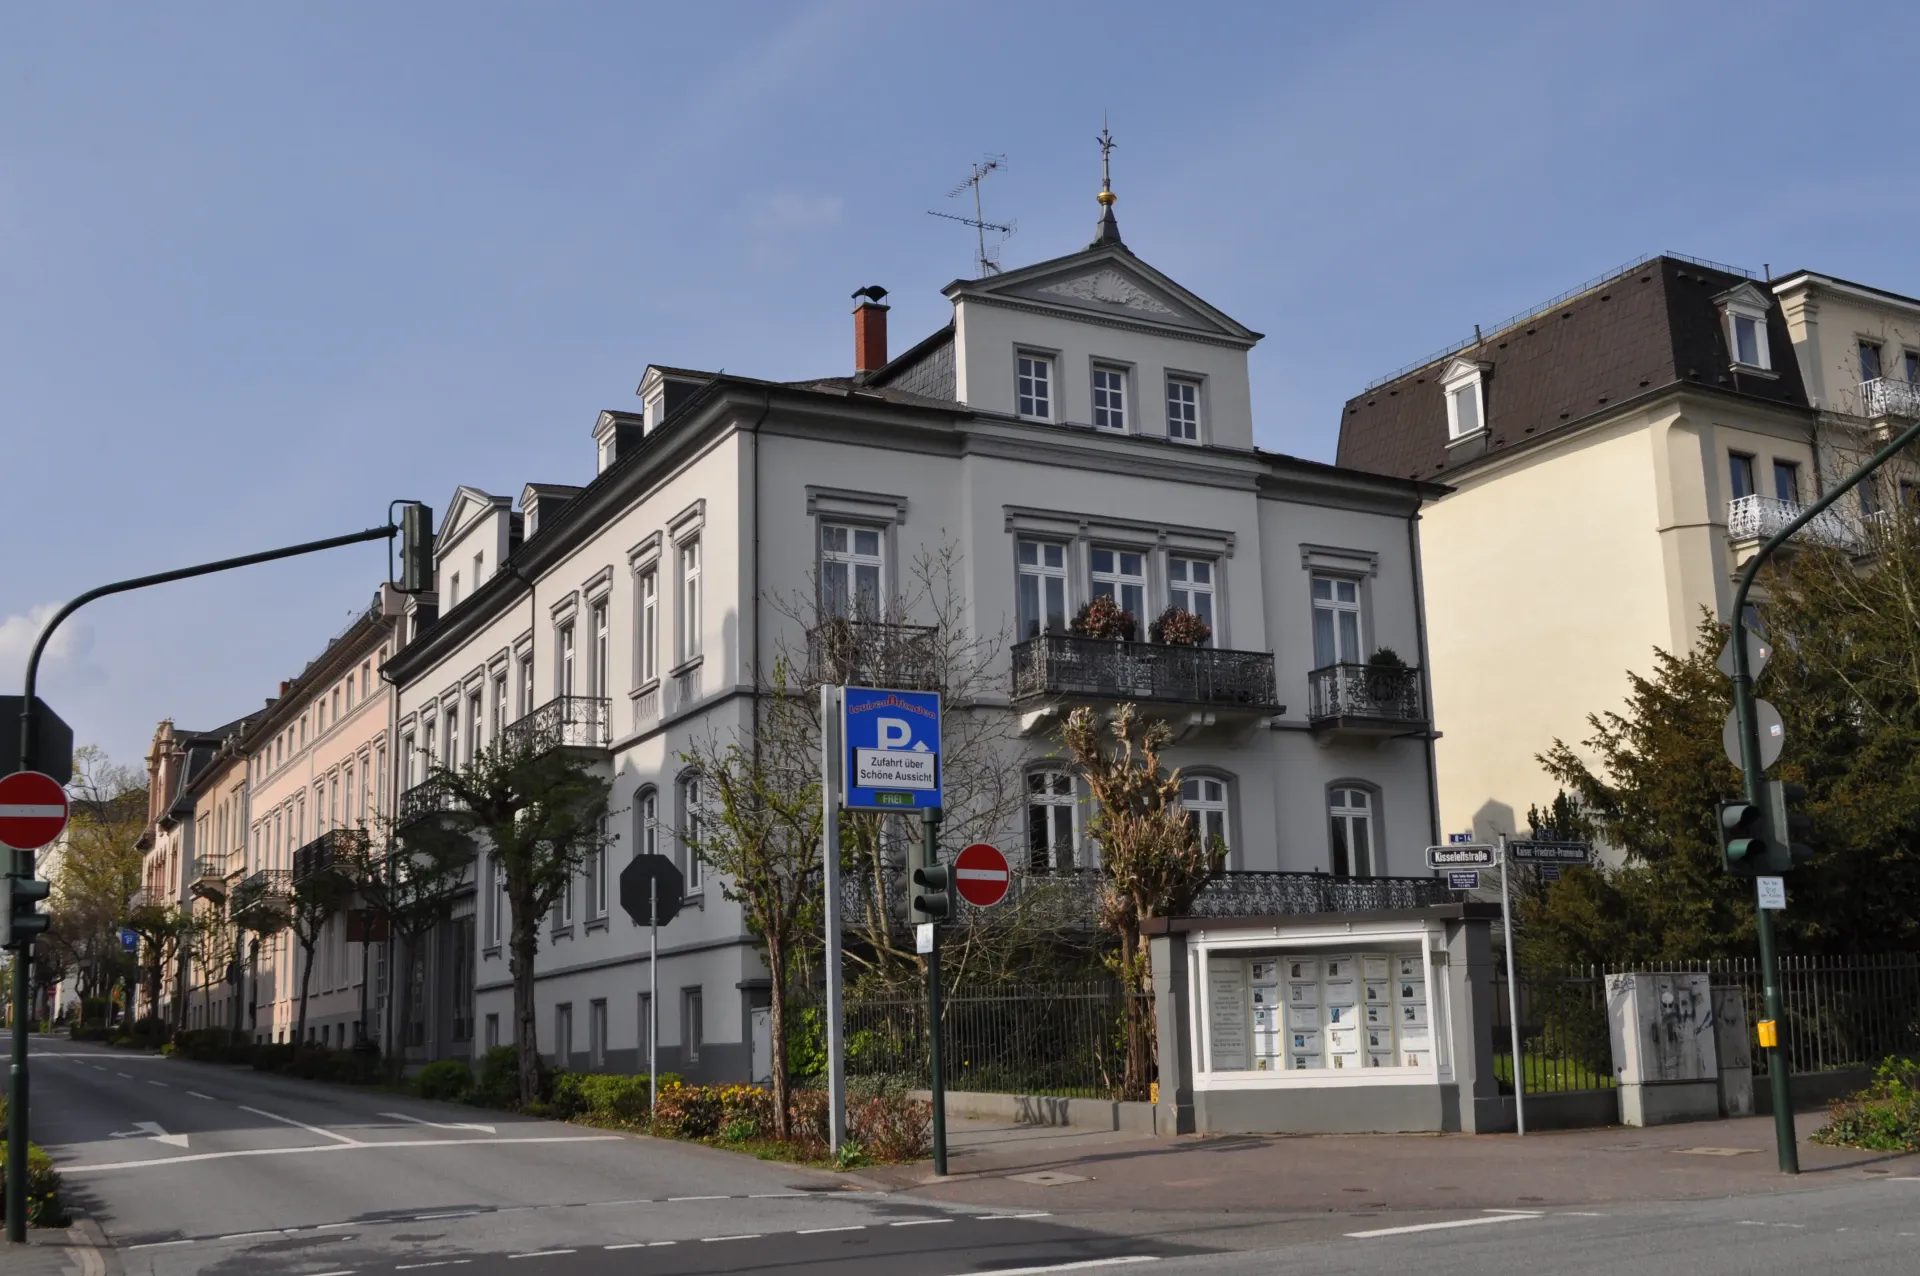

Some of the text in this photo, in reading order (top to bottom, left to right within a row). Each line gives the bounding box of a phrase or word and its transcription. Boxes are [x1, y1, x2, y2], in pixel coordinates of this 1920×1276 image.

[877, 717, 912, 750] P
[871, 757, 924, 769] Zufahrt über
[860, 769, 932, 782] Schöne Aussicht
[882, 794, 902, 804] FREI
[1435, 850, 1488, 862] Kisseleffstraße
